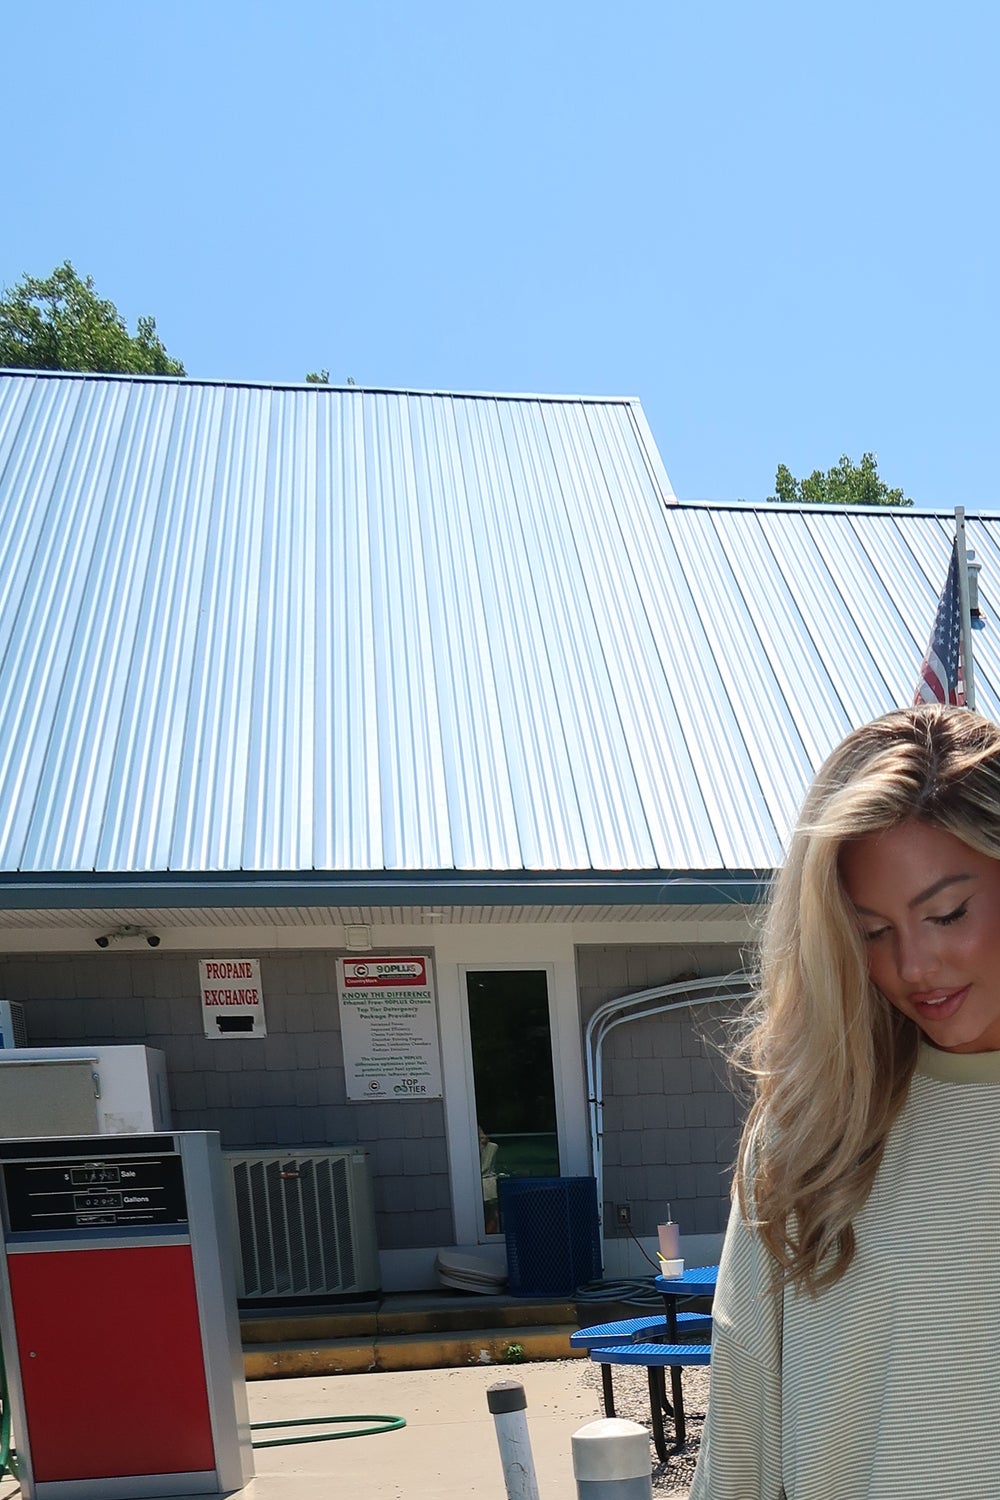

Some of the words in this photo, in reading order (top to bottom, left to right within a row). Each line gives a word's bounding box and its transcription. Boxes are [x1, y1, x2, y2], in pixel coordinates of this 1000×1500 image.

[205, 962, 253, 979] PROPANE
[376, 965, 416, 973] 90PLUS
[204, 989, 259, 1006] EXCHANGE
[408, 1085, 426, 1093] TIER
[121, 1170, 136, 1178] Sale
